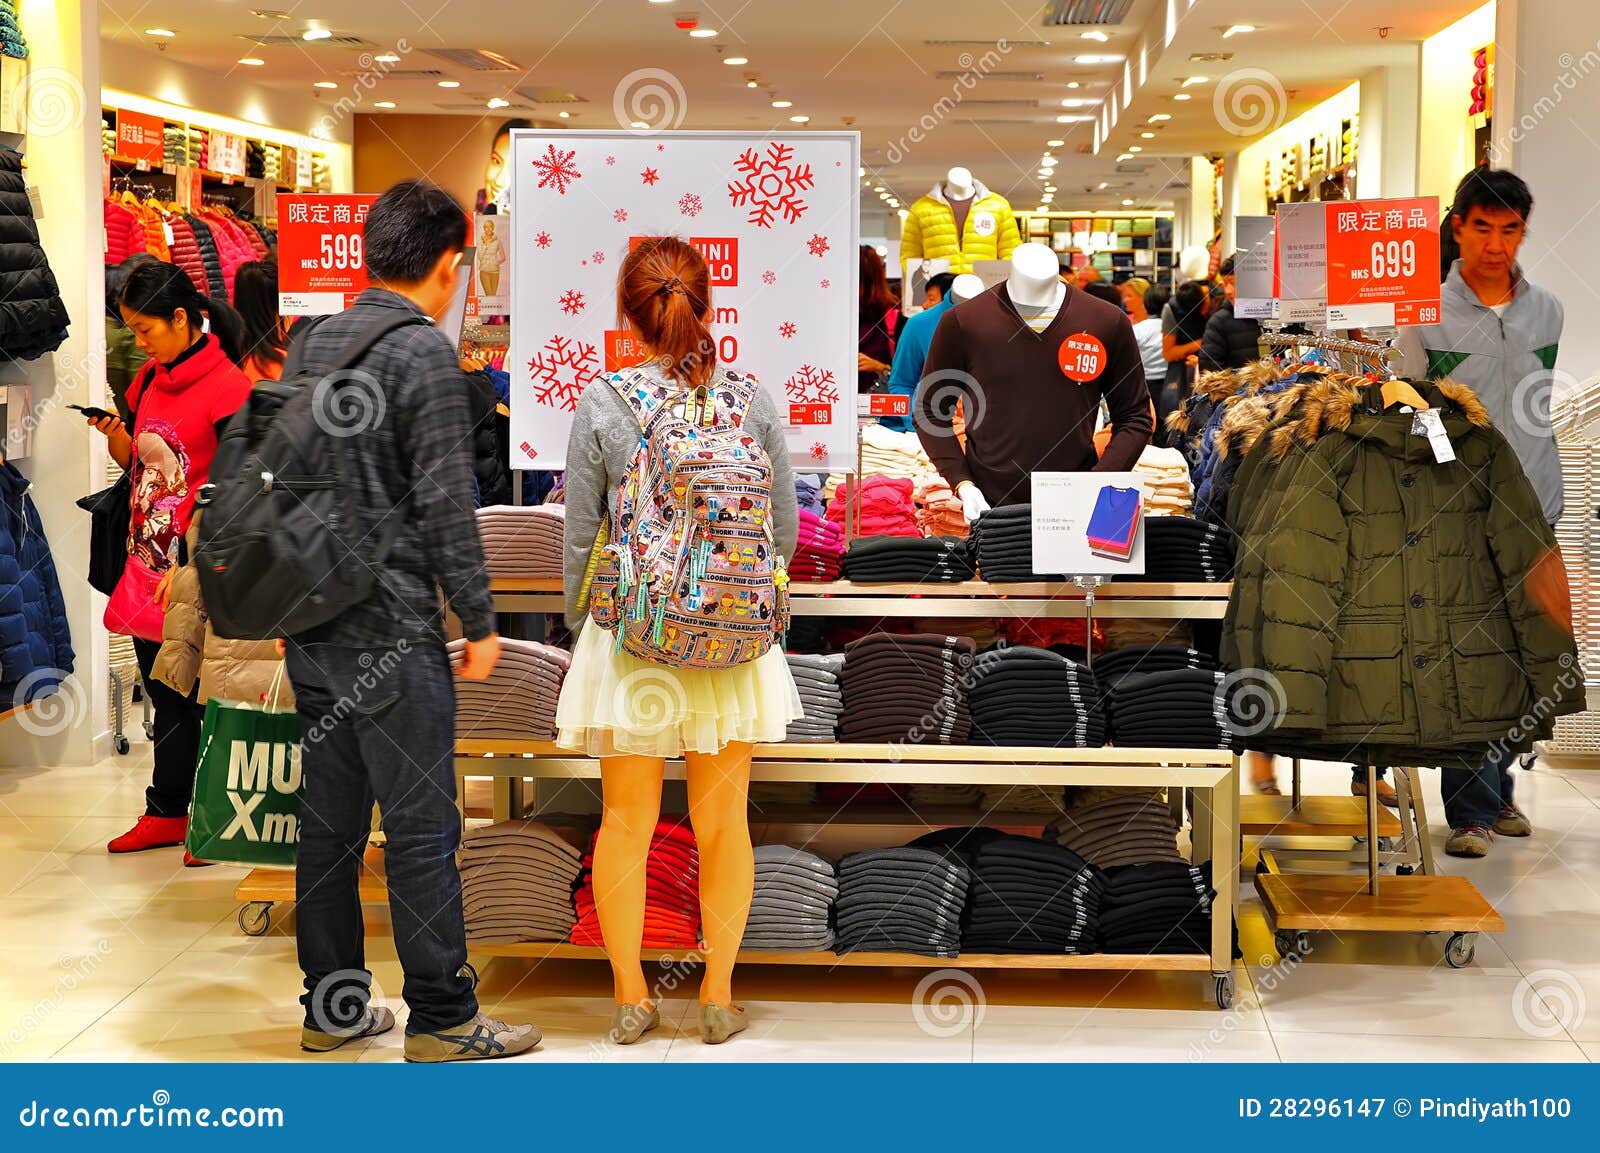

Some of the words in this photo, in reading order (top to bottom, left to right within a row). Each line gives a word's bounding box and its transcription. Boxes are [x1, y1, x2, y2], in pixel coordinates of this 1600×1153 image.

[288, 203, 369, 223] 限定商品
[1337, 208, 1428, 233] 限定商品
[320, 233, 363, 270] 599
[1371, 240, 1416, 279] 699
[710, 263, 733, 281] LO
[465, 301, 476, 314] 99
[1419, 307, 1437, 322] 699
[719, 335, 738, 363] 0
[1076, 353, 1098, 374] 199
[813, 409, 829, 423] 199
[893, 401, 906, 414] 149
[664, 612, 680, 621] AKES
[698, 618, 720, 628] WORK!
[227, 740, 306, 795] MU
[219, 790, 302, 844] Xm
